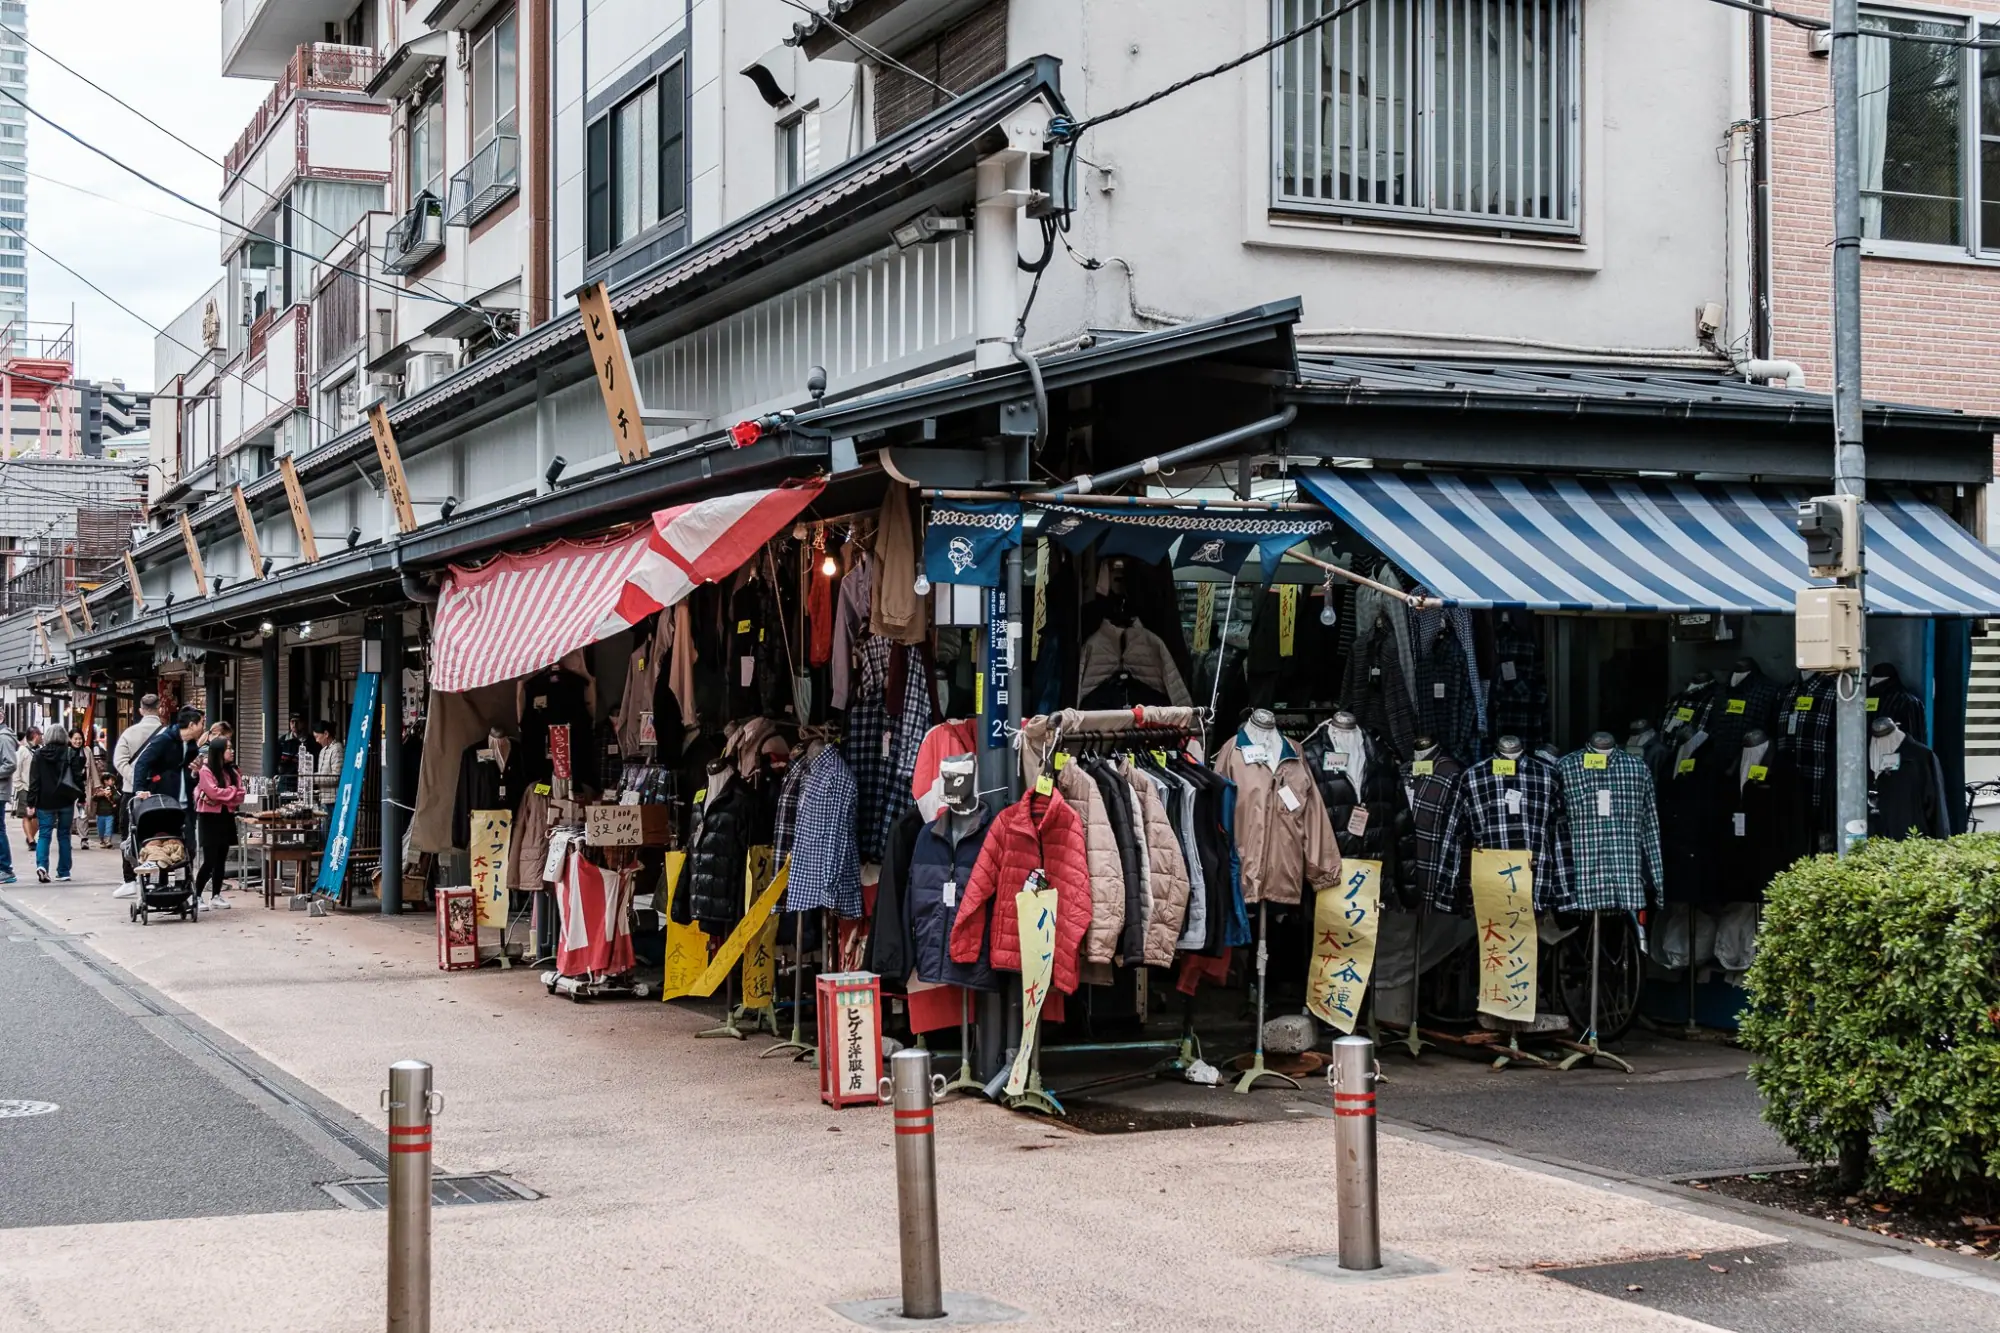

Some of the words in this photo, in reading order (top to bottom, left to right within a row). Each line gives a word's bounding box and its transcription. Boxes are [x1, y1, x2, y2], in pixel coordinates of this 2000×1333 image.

[473, 855, 490, 920] 大サービス
[486, 819, 508, 902] ハーフコート
[1311, 929, 1342, 1016] 大サービス
[1324, 868, 1371, 1018] ダウン各種
[1480, 917, 1508, 1004] 大奉仕
[1498, 862, 1531, 1012] オープンシャツ
[847, 1008, 864, 1090] ヒグチ洋服店
